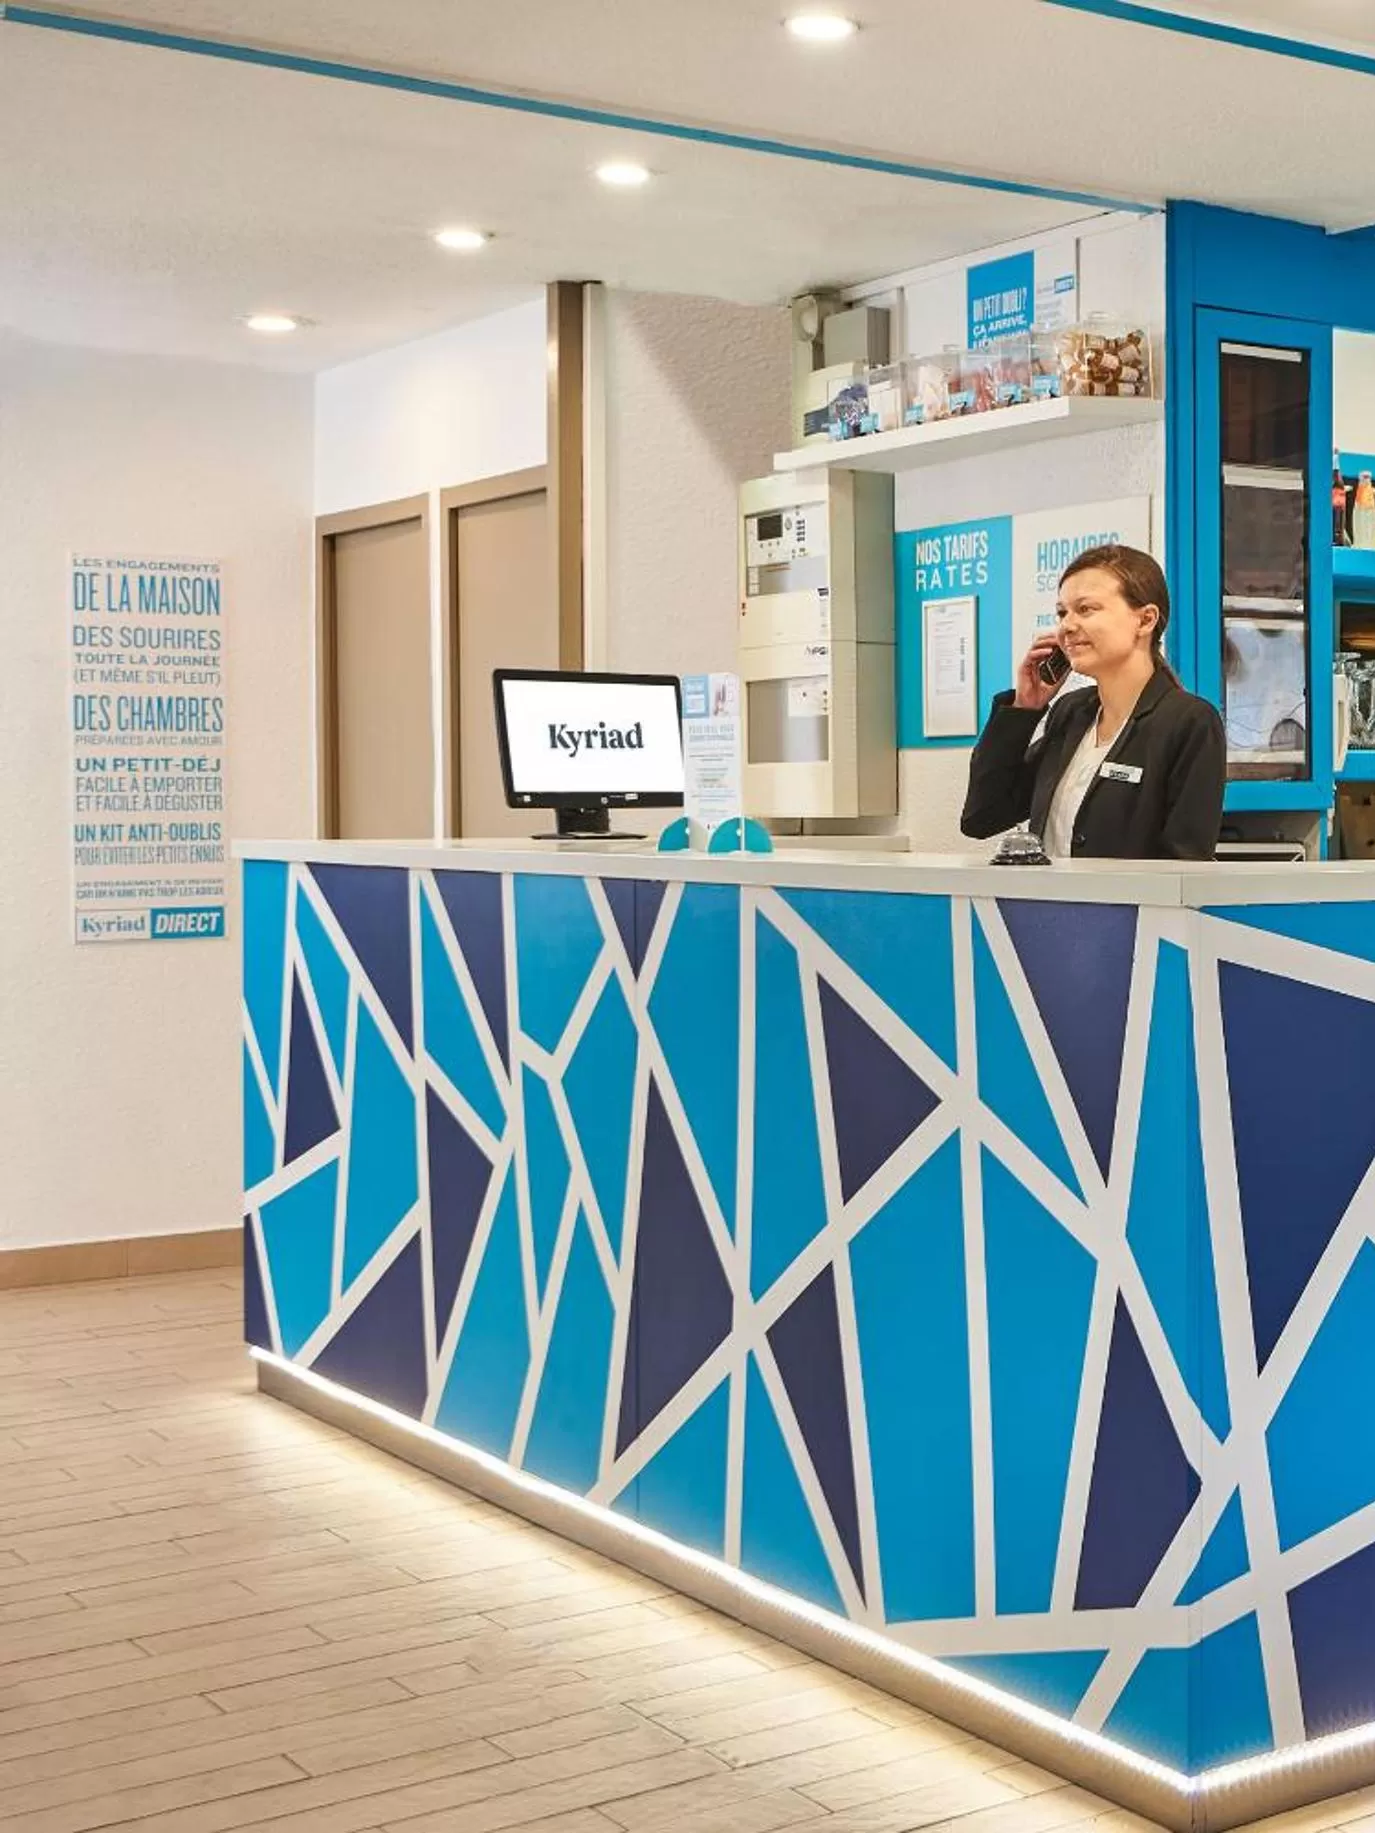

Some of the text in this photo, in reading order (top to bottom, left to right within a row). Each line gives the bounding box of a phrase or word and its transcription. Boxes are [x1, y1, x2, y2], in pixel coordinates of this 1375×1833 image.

[916, 530, 988, 566] NOS TARIFS
[72, 558, 220, 573] LES ENGAGEMENTS
[916, 561, 988, 592] RATES
[73, 571, 220, 616] DE LA MAISON
[73, 625, 221, 651] DES SOURIRES
[75, 652, 124, 665] TOUTE
[129, 653, 149, 665] LA
[74, 668, 97, 685] (ET
[73, 694, 223, 732] DES CHAMBRES
[548, 721, 644, 757] Kyriad
[76, 755, 221, 773] UN PETIT-DÉJ
[76, 776, 127, 793] FACILE
[144, 776, 223, 793] EMPORTER
[76, 795, 92, 811] ET
[96, 795, 139, 811] FACILE
[75, 822, 221, 842] UN KIT ANTI-OUBLIS
[82, 911, 220, 937] Kyriad DIRECT
